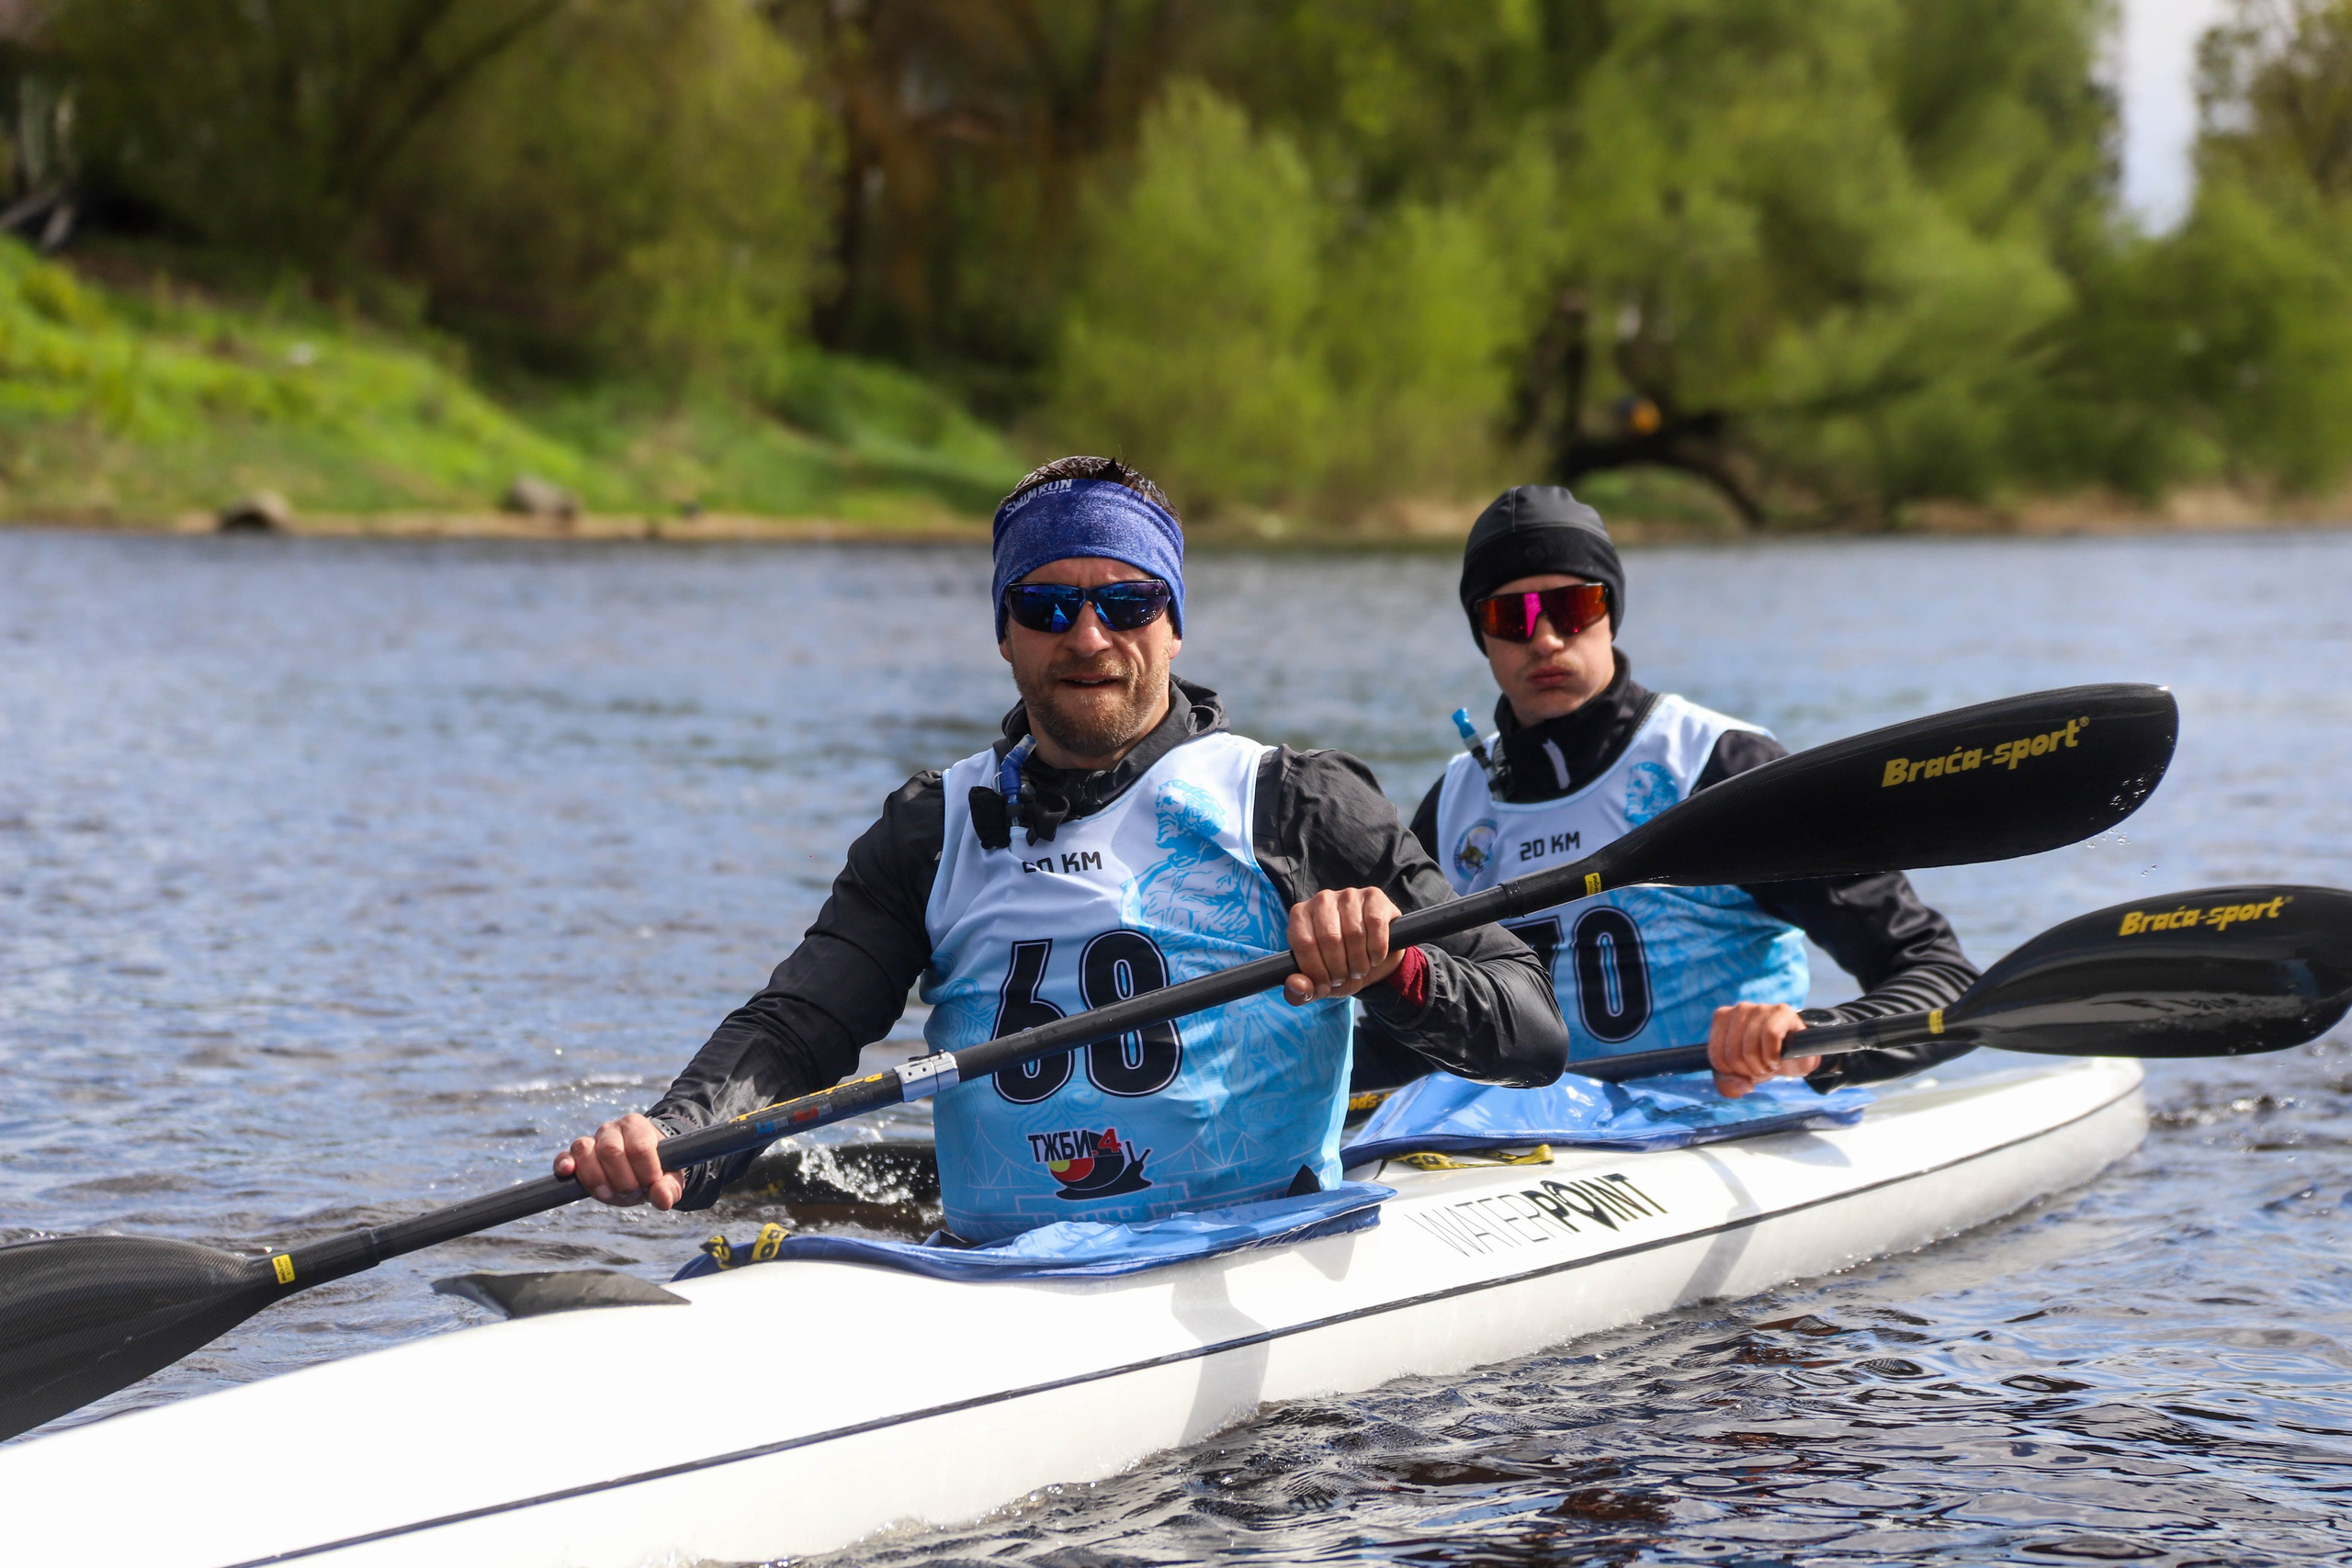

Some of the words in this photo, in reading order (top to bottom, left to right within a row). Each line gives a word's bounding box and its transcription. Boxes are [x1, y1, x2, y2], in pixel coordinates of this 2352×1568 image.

[1520, 838, 1545, 862] 20
[1551, 830, 1580, 854] KM
[1060, 851, 1102, 874] KM
[990, 929, 1183, 1106] 68
